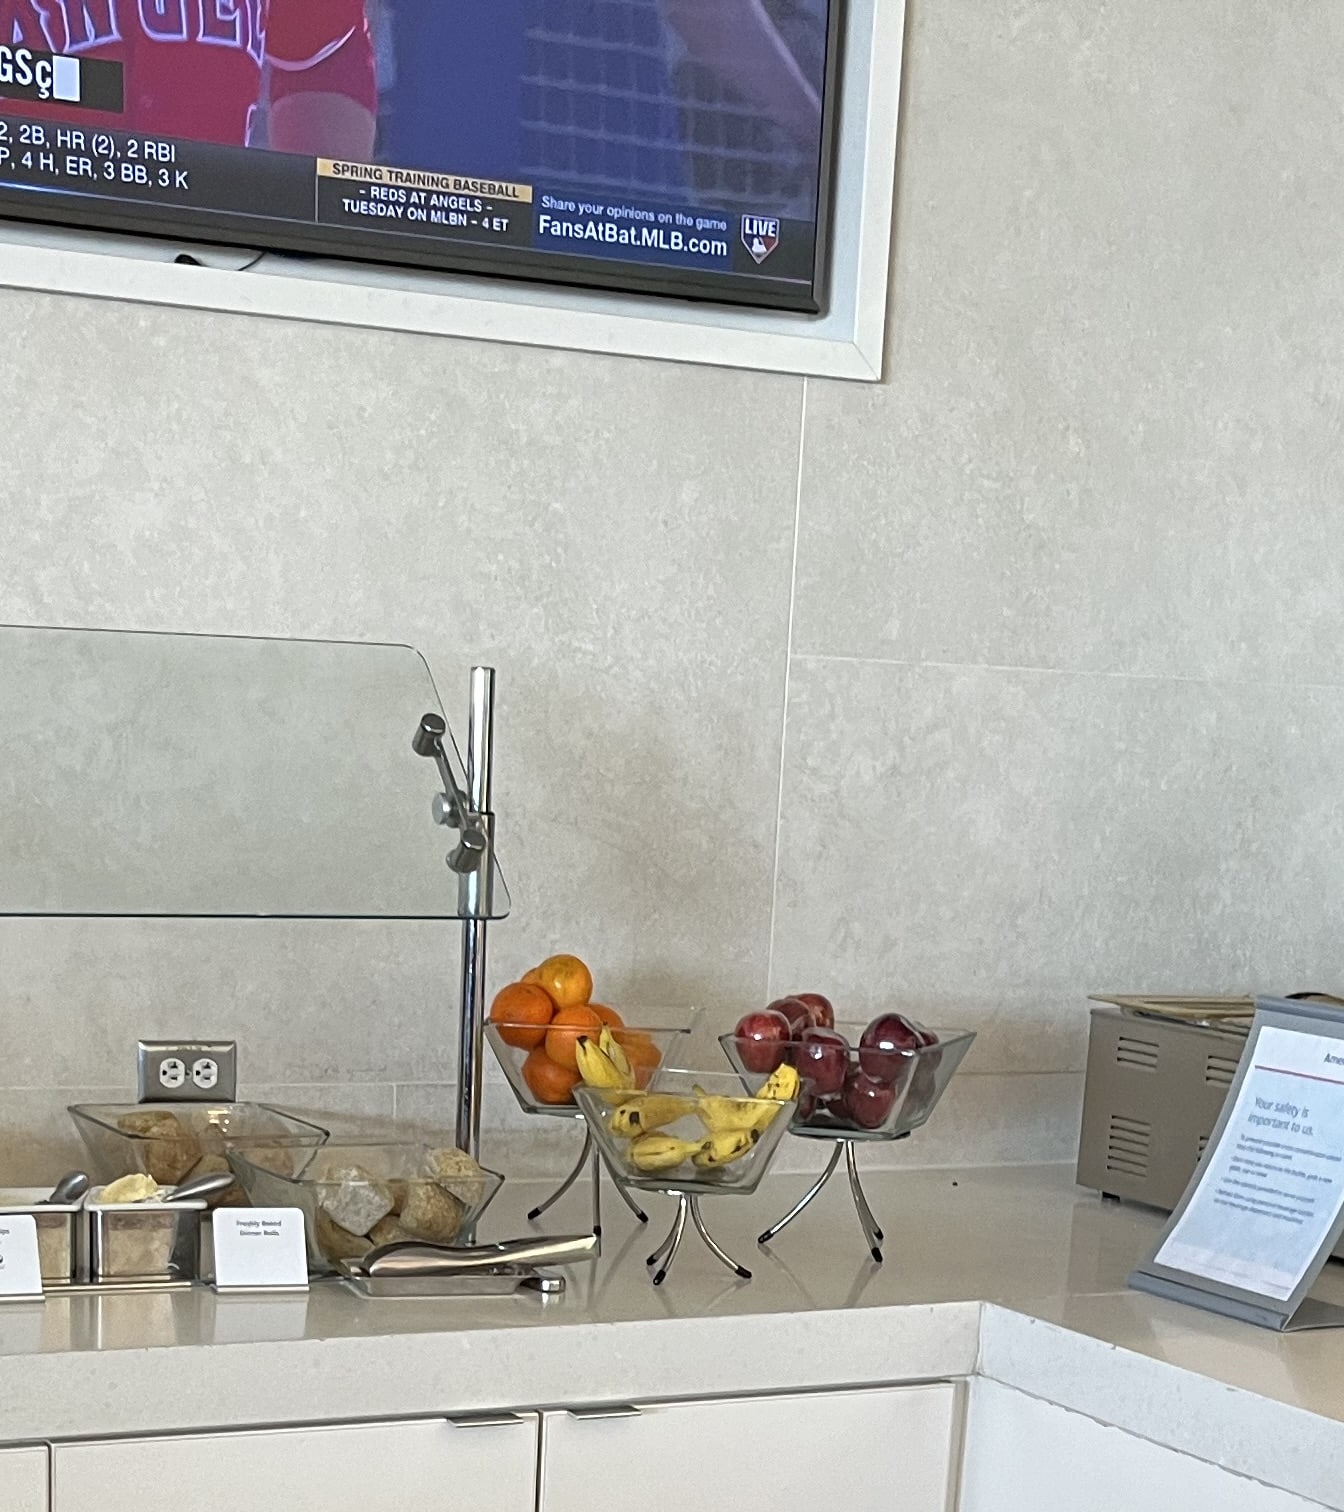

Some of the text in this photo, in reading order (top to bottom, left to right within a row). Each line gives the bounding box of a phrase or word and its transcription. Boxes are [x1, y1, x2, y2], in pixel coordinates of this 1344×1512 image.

[20, 124, 50, 149] 2B,
[57, 130, 85, 151] HR
[92, 134, 121, 160] (2),
[127, 139, 139, 158] 2
[145, 140, 176, 163] RBI
[21, 150, 33, 168] 4
[39, 153, 59, 175] H,
[66, 157, 98, 181] ER,
[103, 161, 115, 180] 3
[121, 164, 153, 187] BB,
[158, 168, 169, 186] 3
[175, 171, 189, 190] K
[332, 162, 519, 199] SPRING TRAINING BASEBALL
[342, 198, 509, 232] TUESDAY ON MLBN 4 ET
[371, 186, 483, 212] REDS AT ANGELS
[542, 195, 727, 232] Share your opinions on the game
[538, 214, 727, 257] FansAtBat.MLB.com
[744, 218, 777, 238] LIVE
